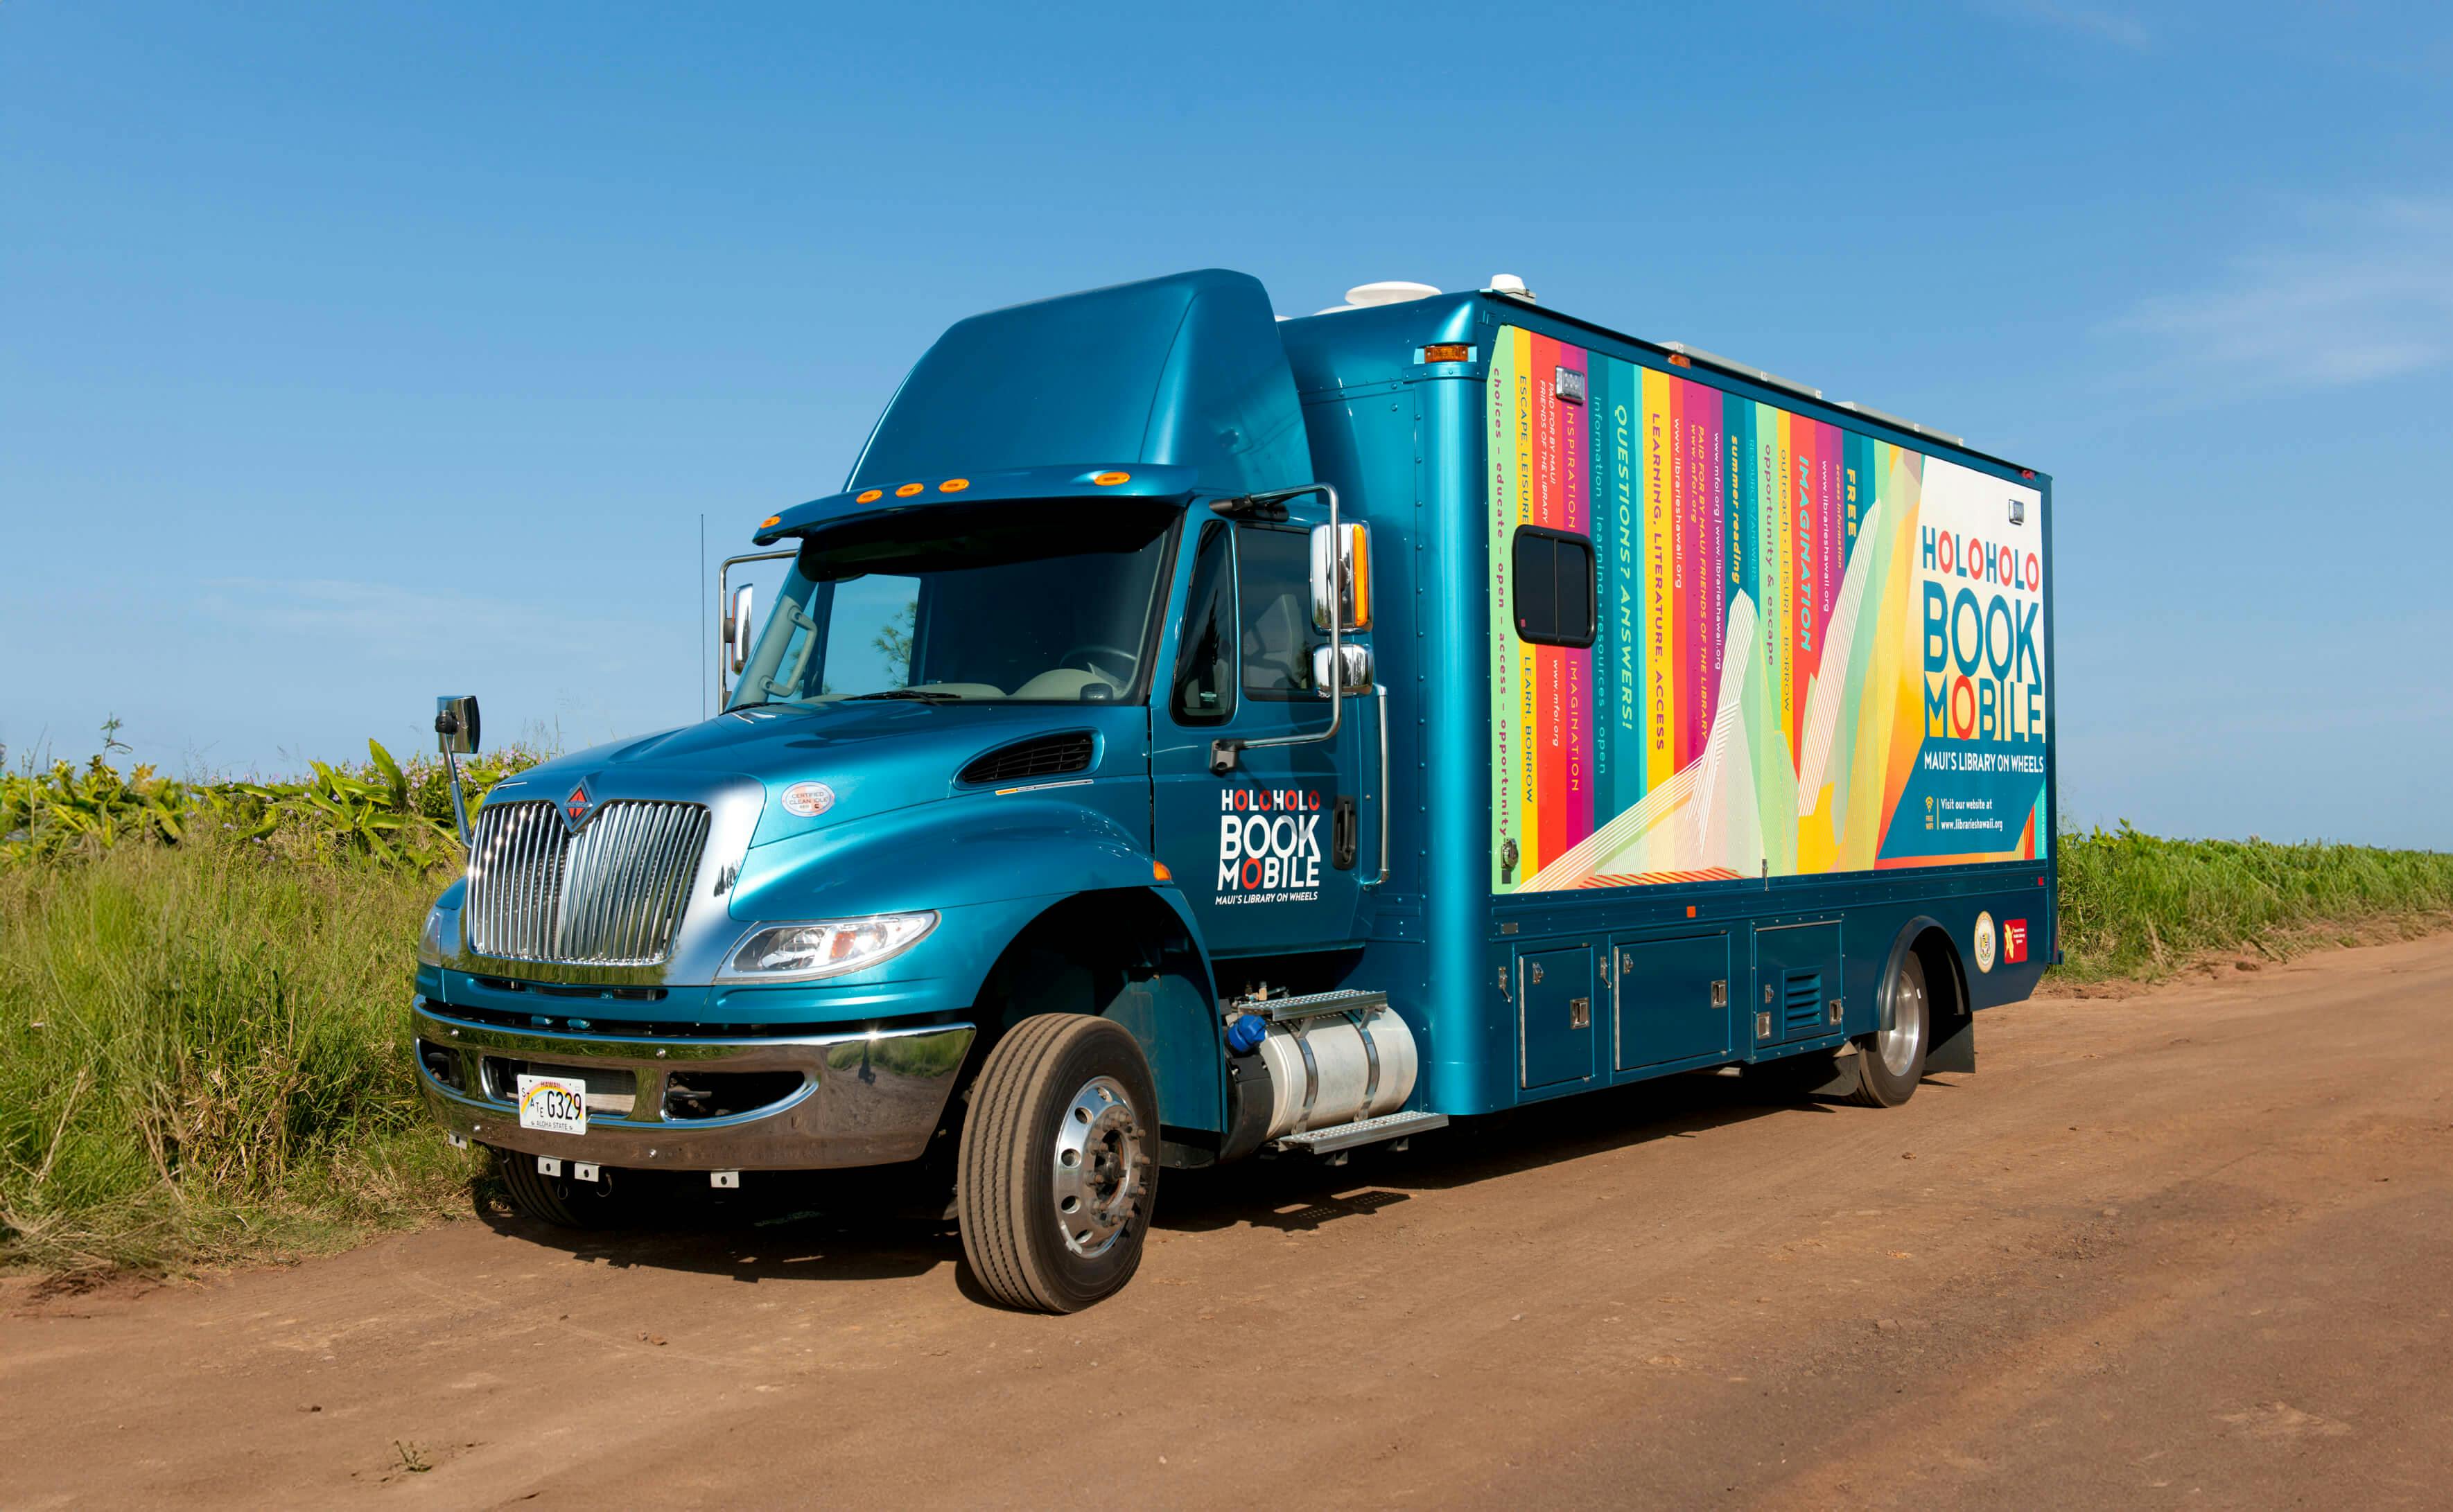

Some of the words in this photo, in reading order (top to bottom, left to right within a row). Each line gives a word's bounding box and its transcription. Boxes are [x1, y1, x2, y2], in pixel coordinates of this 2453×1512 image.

[1519, 376, 1528, 445] ESCAPE,
[1541, 431, 1547, 450] OF
[1549, 437, 1555, 454] BY
[1566, 405, 1575, 528] INSPIRATION
[1595, 397, 1603, 496] information
[1652, 413, 1661, 525] LEARNING,
[1521, 453, 1529, 525] LEISURE
[1615, 405, 1630, 579] QUESTIONS?
[1674, 419, 1682, 589] www.librarieshawaii.org
[1699, 494, 1706, 514] BY
[1764, 445, 1774, 567] opportunity
[1847, 468, 1857, 538] FREE
[1731, 513, 1740, 585] reading
[1799, 456, 1811, 651] IMAGINATION
[1922, 525, 2040, 592] HOLOHOLO
[1494, 368, 1502, 439] choices
[1499, 719, 1509, 836] opportunity
[1654, 532, 1664, 663] LITERATURE,
[1700, 623, 1706, 643] OF
[1923, 580, 2041, 683] BOOK
[1596, 614, 1605, 705] resources
[1621, 586, 1632, 730] ANSWERS!
[1570, 661, 1579, 791] IMAGINATION
[1655, 670, 1664, 750] ACCESS
[1924, 671, 2043, 744] MOBILE
[1597, 727, 1605, 774] open
[1924, 751, 1957, 771] MAUI'S
[1959, 753, 1996, 772] LIBRARY
[1997, 754, 2009, 772] ON
[2011, 755, 2044, 773] WHEELS
[1221, 789, 1320, 811] HOLOHOLO
[1941, 798, 1955, 810] Visit
[1955, 801, 1965, 809] our
[1966, 799, 1985, 810] website
[1986, 799, 1993, 810] at
[1941, 818, 2003, 832] www.librarieshawaii.org
[1221, 814, 1320, 860] BOOK
[1215, 894, 1243, 905] MAUI'S
[1243, 893, 1275, 904] LIBRARY
[1276, 893, 1288, 902] ON
[1289, 891, 1318, 902] WHEELS
[1217, 856, 1321, 890] MOBILE
[541, 1081, 561, 1089] HAWAII
[548, 1090, 582, 1120] G329
